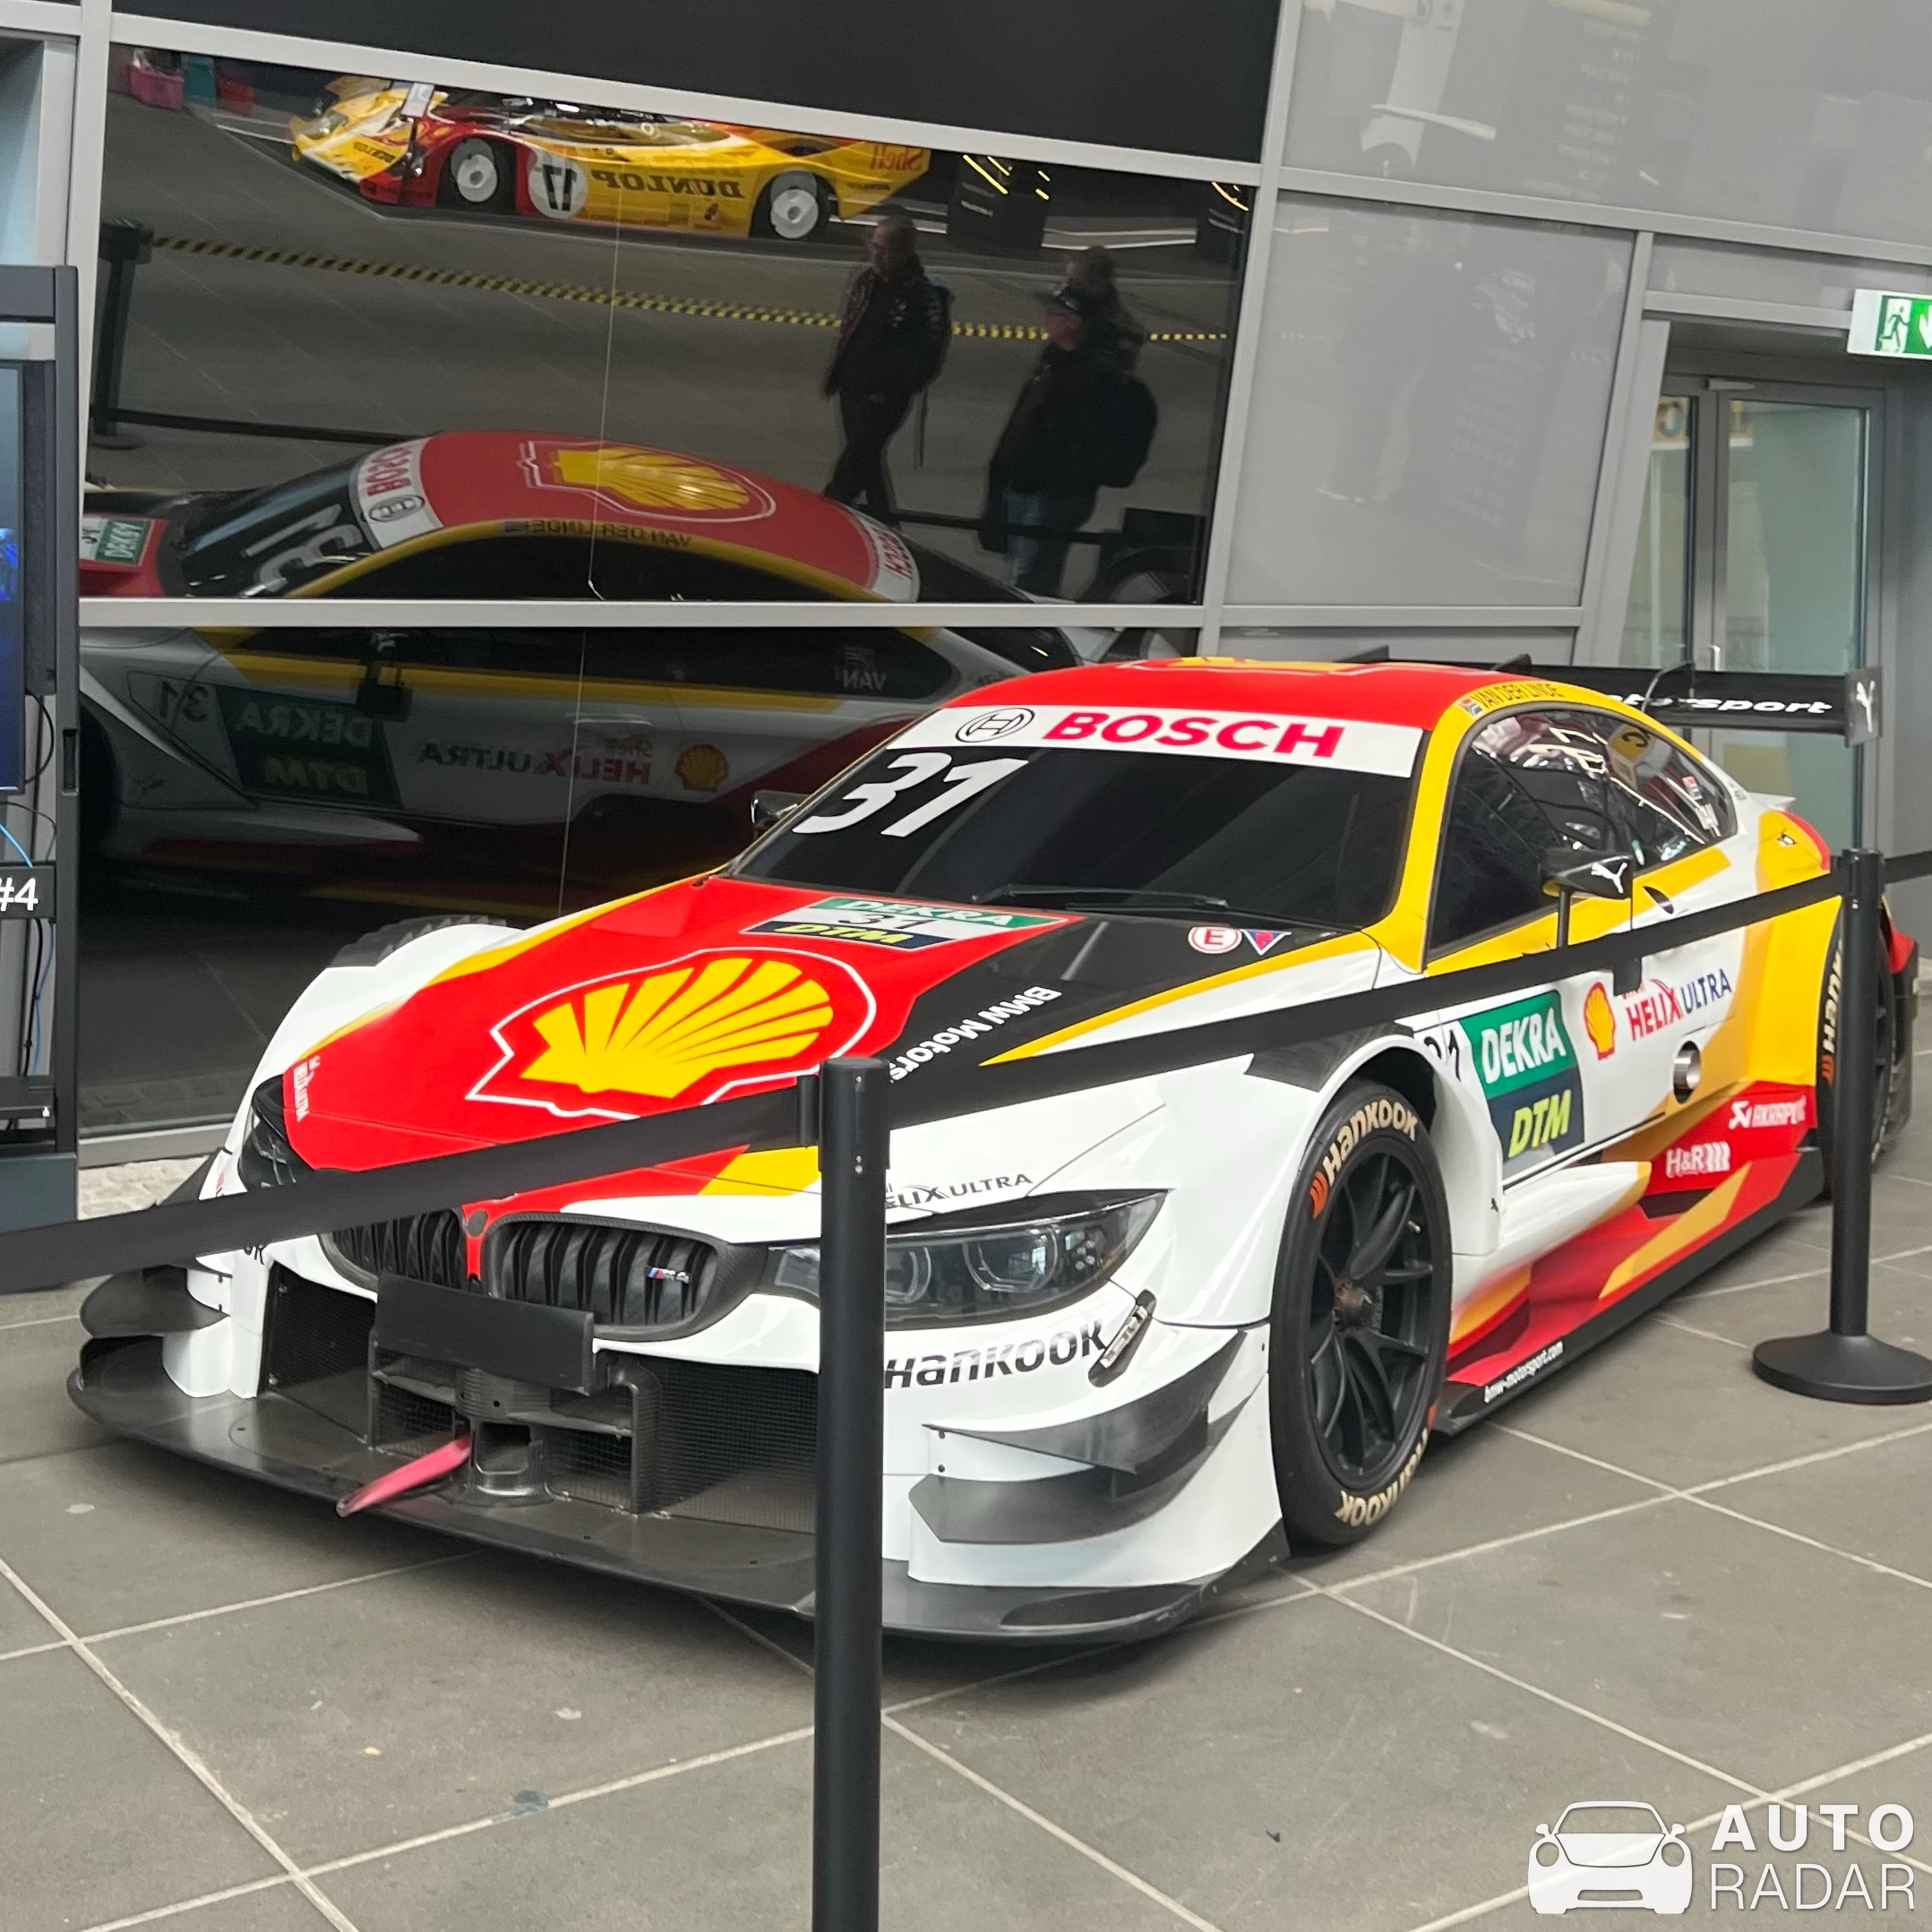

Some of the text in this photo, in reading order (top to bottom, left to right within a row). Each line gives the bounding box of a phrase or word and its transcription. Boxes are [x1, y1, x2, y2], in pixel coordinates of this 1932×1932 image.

[1042, 711, 1345, 759] BOSCH
[792, 751, 1029, 837] 31
[0, 877, 39, 912] #4
[835, 900, 1014, 926] DEKRA
[775, 923, 914, 944] DTM
[837, 914, 938, 930] 31
[978, 985, 1062, 1025] BMW
[1625, 968, 1732, 1041] HELIX ULTRA
[1481, 1009, 1567, 1084] DEKRA
[1507, 1089, 1571, 1158] DTM
[885, 1185, 949, 1209] ELIX
[949, 1173, 1034, 1197] ULTRA
